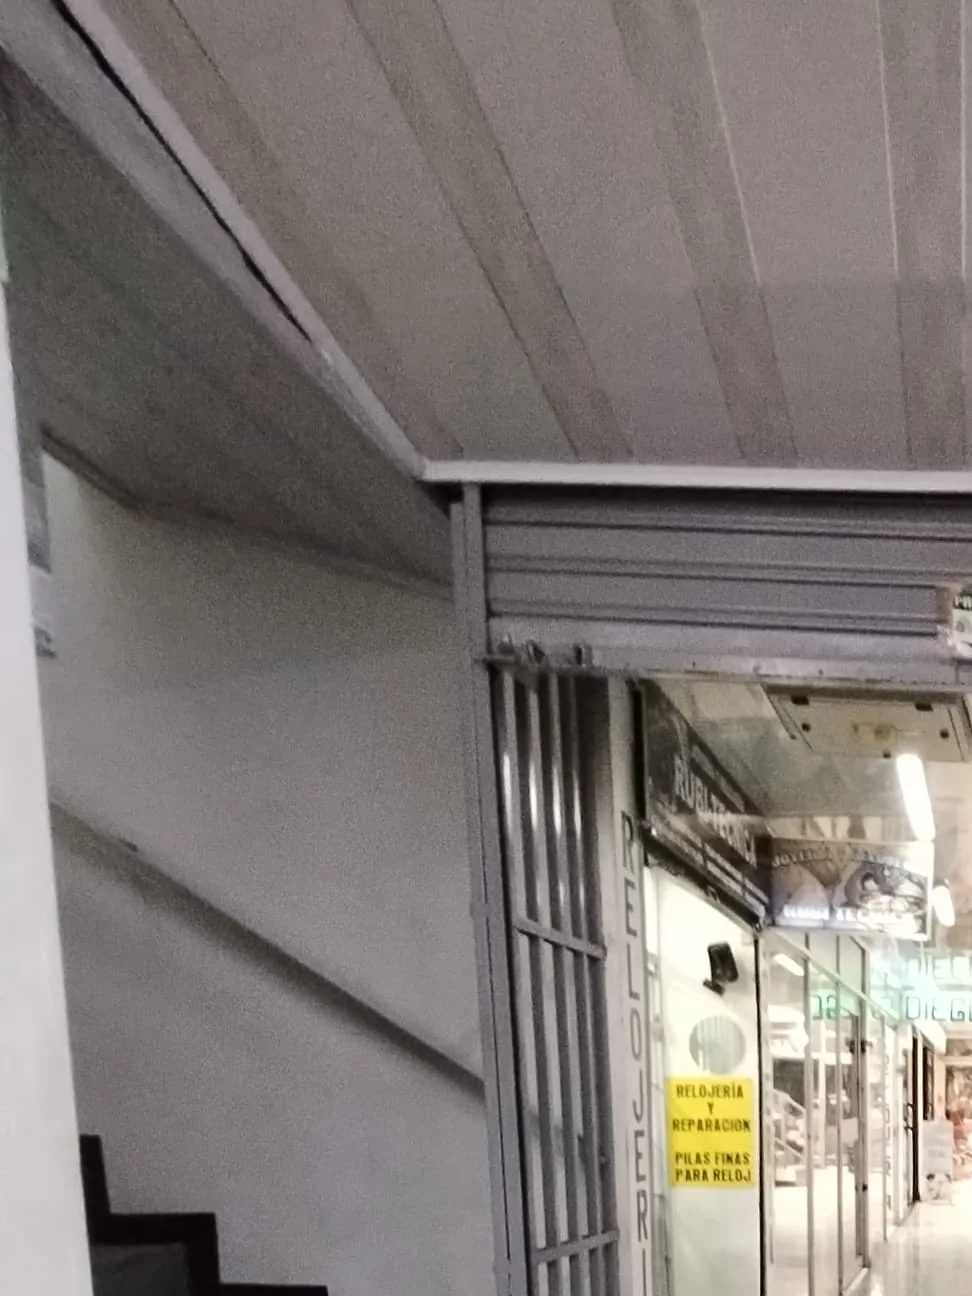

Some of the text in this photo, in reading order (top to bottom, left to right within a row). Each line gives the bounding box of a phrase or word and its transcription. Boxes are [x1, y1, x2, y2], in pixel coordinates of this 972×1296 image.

[707, 1101, 714, 1115] Y
[675, 1151, 751, 1165] PILAS FINAS
[675, 1167, 751, 1182] PARA RELOJ
